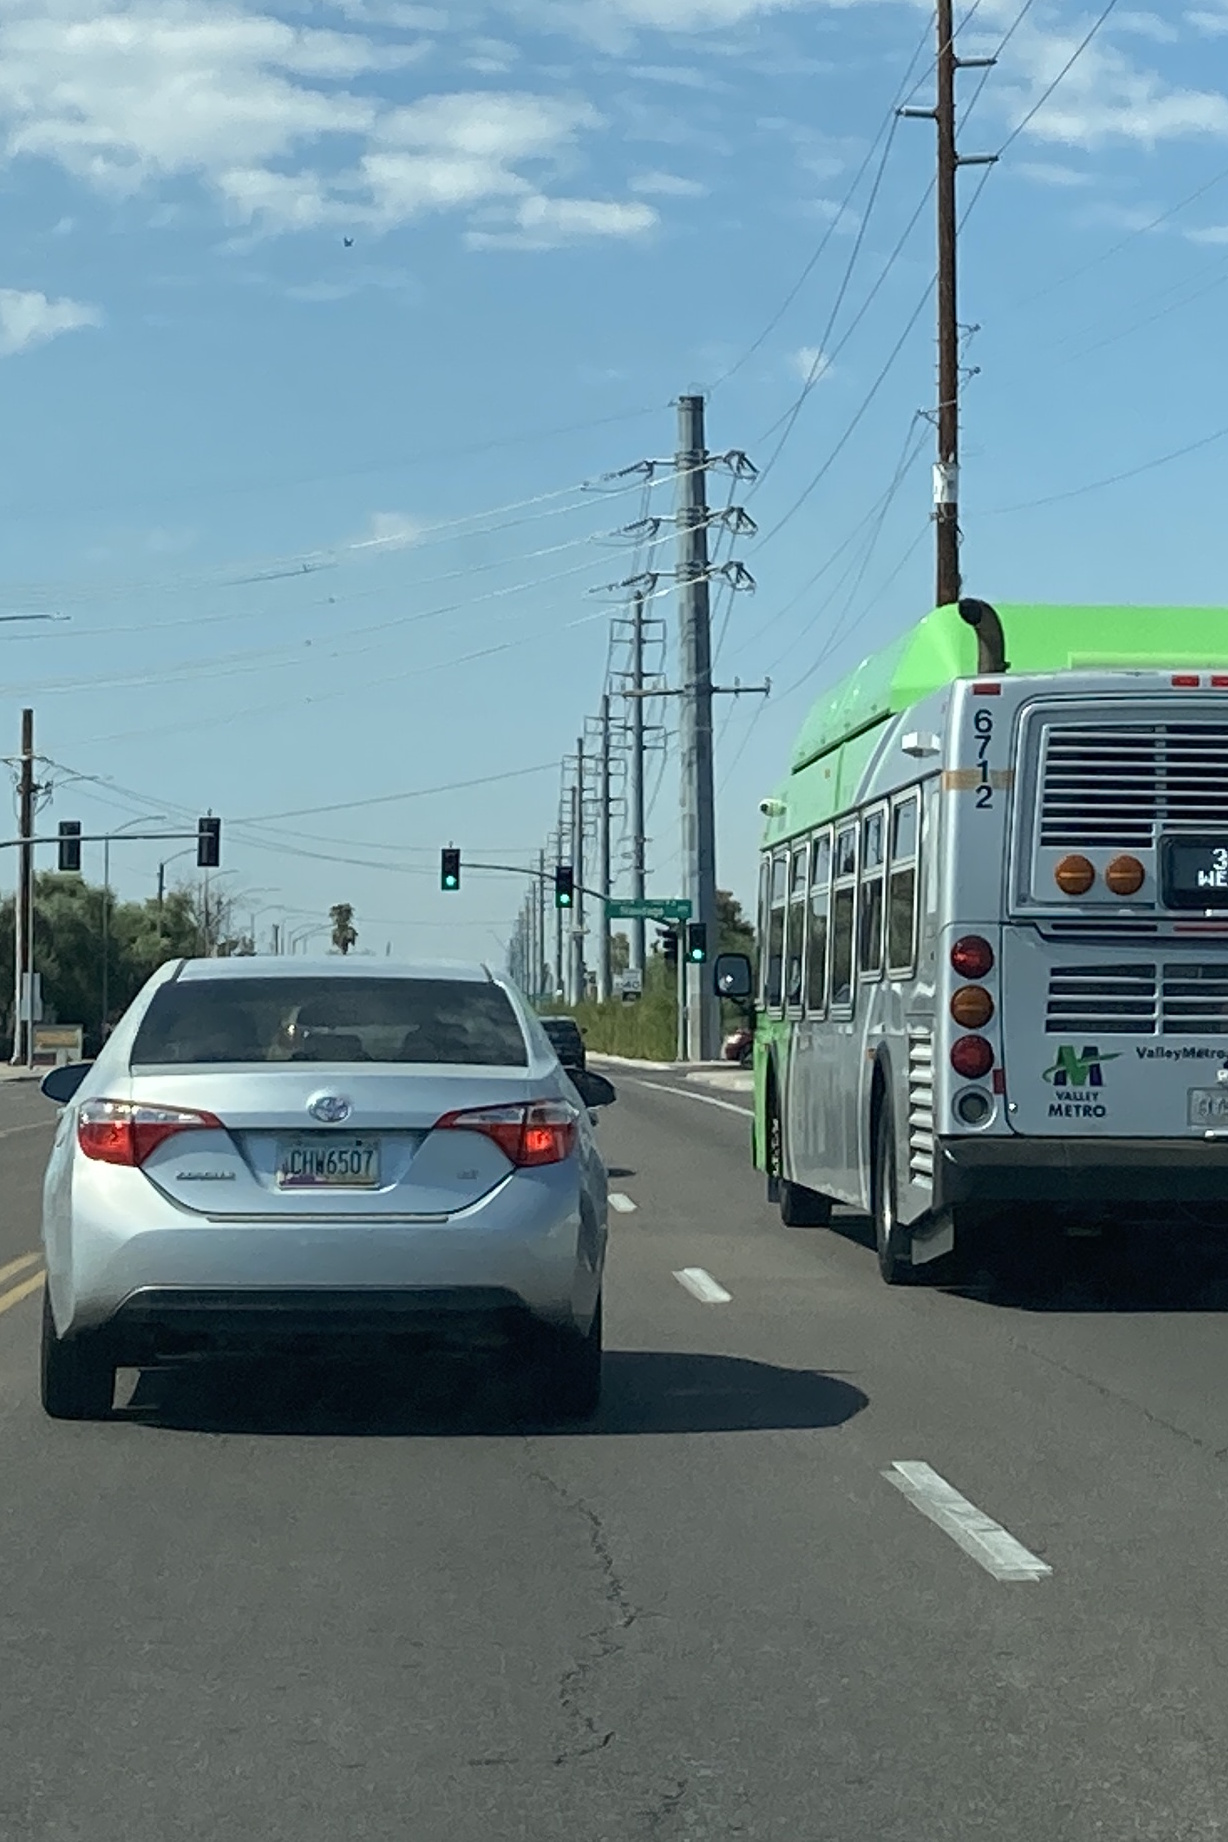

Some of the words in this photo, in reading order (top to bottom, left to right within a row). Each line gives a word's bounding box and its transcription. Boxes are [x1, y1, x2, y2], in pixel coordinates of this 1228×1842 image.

[974, 708, 993, 809] 6712
[1055, 1091, 1099, 1102] VALLEY
[1048, 1104, 1106, 1118] METRO
[290, 1149, 374, 1175] CHW6507
